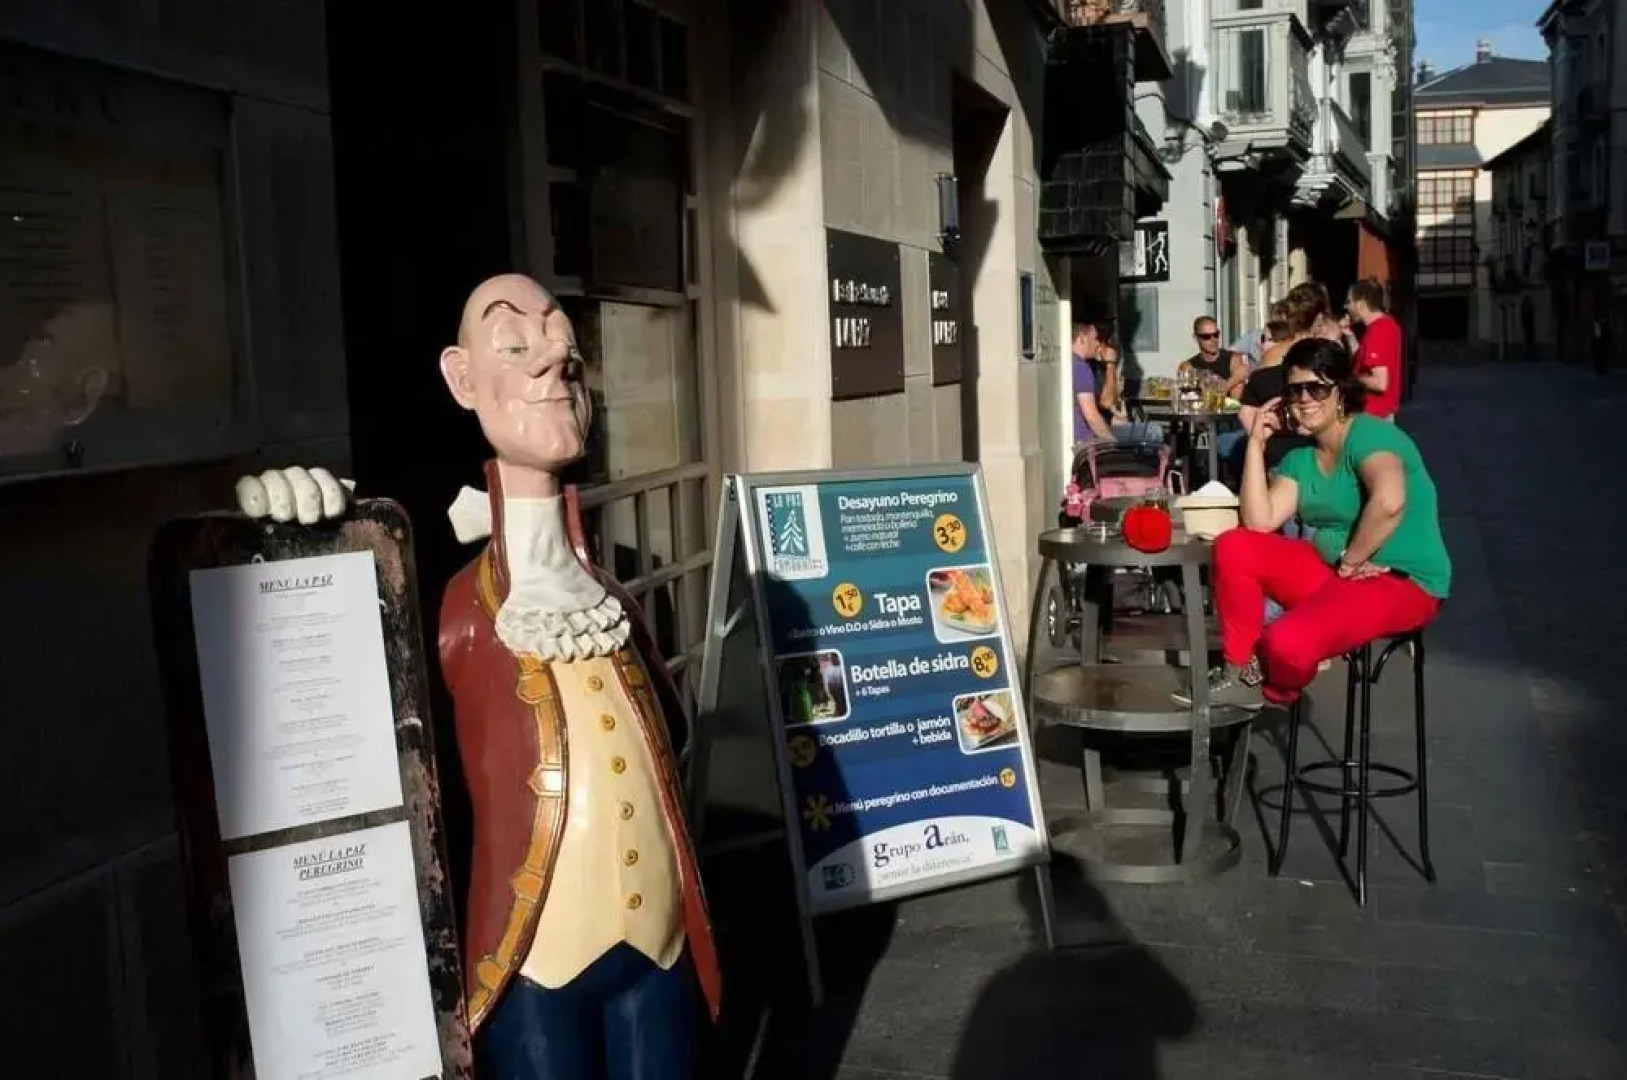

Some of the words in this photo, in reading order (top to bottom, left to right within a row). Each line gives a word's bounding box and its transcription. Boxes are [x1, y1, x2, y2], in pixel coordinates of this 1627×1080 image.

[837, 495, 900, 512] Desayuno
[900, 490, 958, 507] Peregrino
[873, 592, 921, 617] Tapa
[825, 624, 845, 636] Vino
[869, 619, 890, 630] Sidra
[897, 616, 923, 627] Mosto
[850, 659, 907, 684] Botella
[908, 656, 929, 676] de
[931, 653, 968, 673] sidra
[867, 685, 890, 698] Tapas
[870, 722, 906, 738] tortilla
[907, 723, 914, 732] o
[916, 716, 951, 732] jamón
[920, 730, 952, 745] bebida
[864, 792, 911, 812] peregrino
[911, 790, 929, 801] con
[929, 776, 998, 797] documentación
[345, 843, 365, 857] PAZ
[874, 842, 921, 868] grupo
